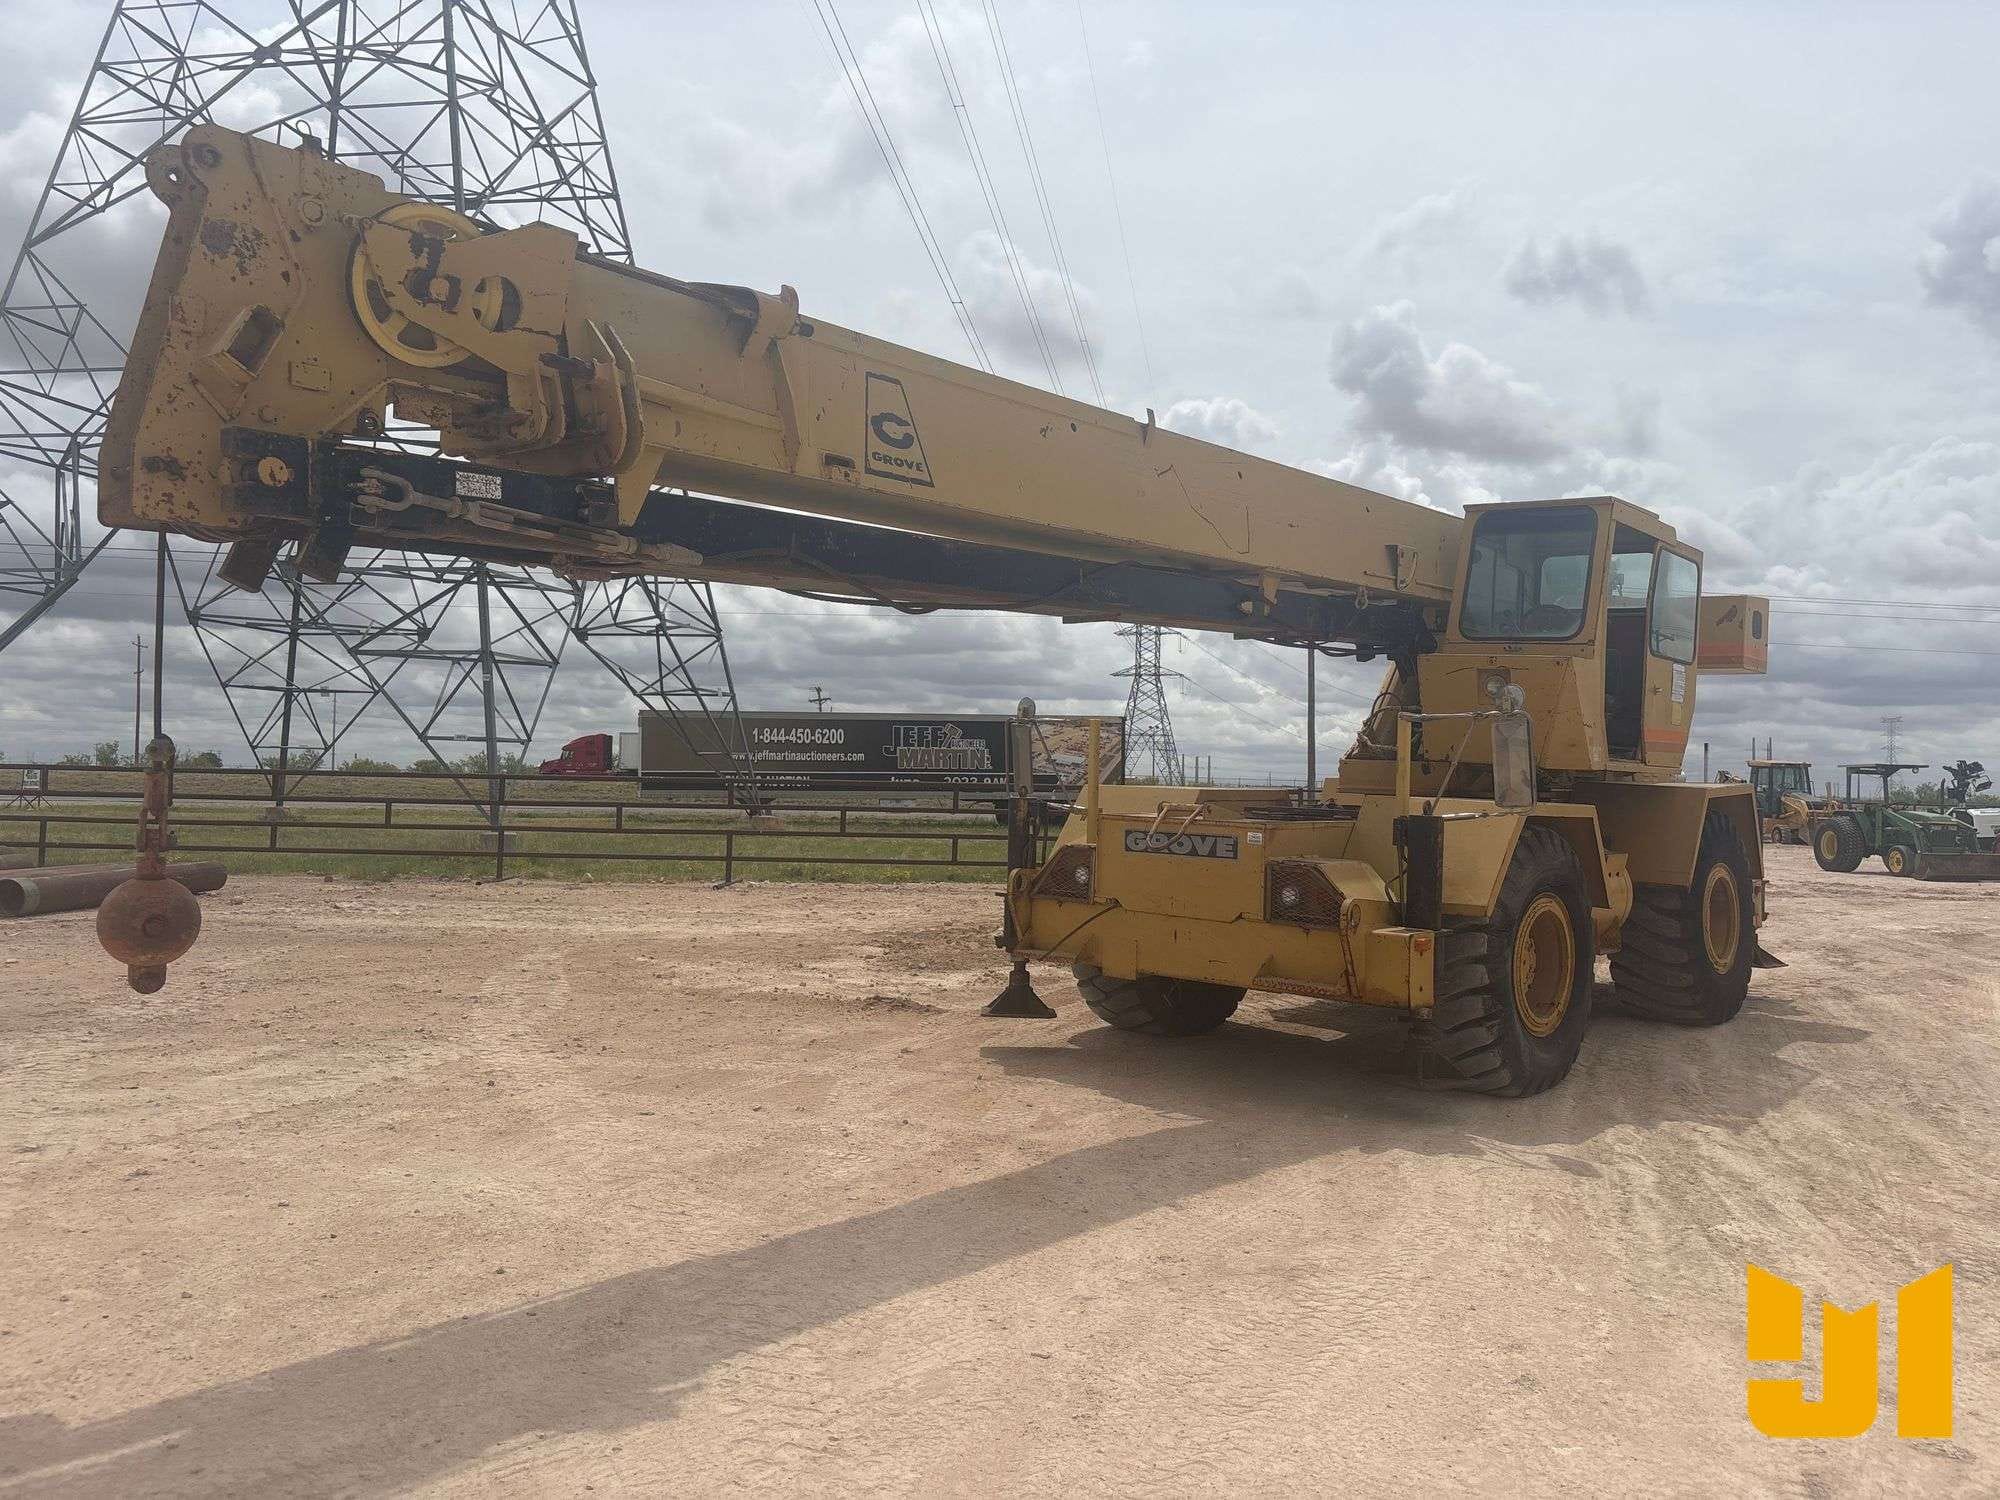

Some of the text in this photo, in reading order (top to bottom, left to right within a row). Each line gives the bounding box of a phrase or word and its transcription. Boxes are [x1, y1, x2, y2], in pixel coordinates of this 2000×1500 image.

[872, 452, 924, 472] GROVE
[752, 728, 845, 744] 1-844-450-6200
[883, 726, 944, 756] JEFF
[896, 747, 985, 769] MARTIN
